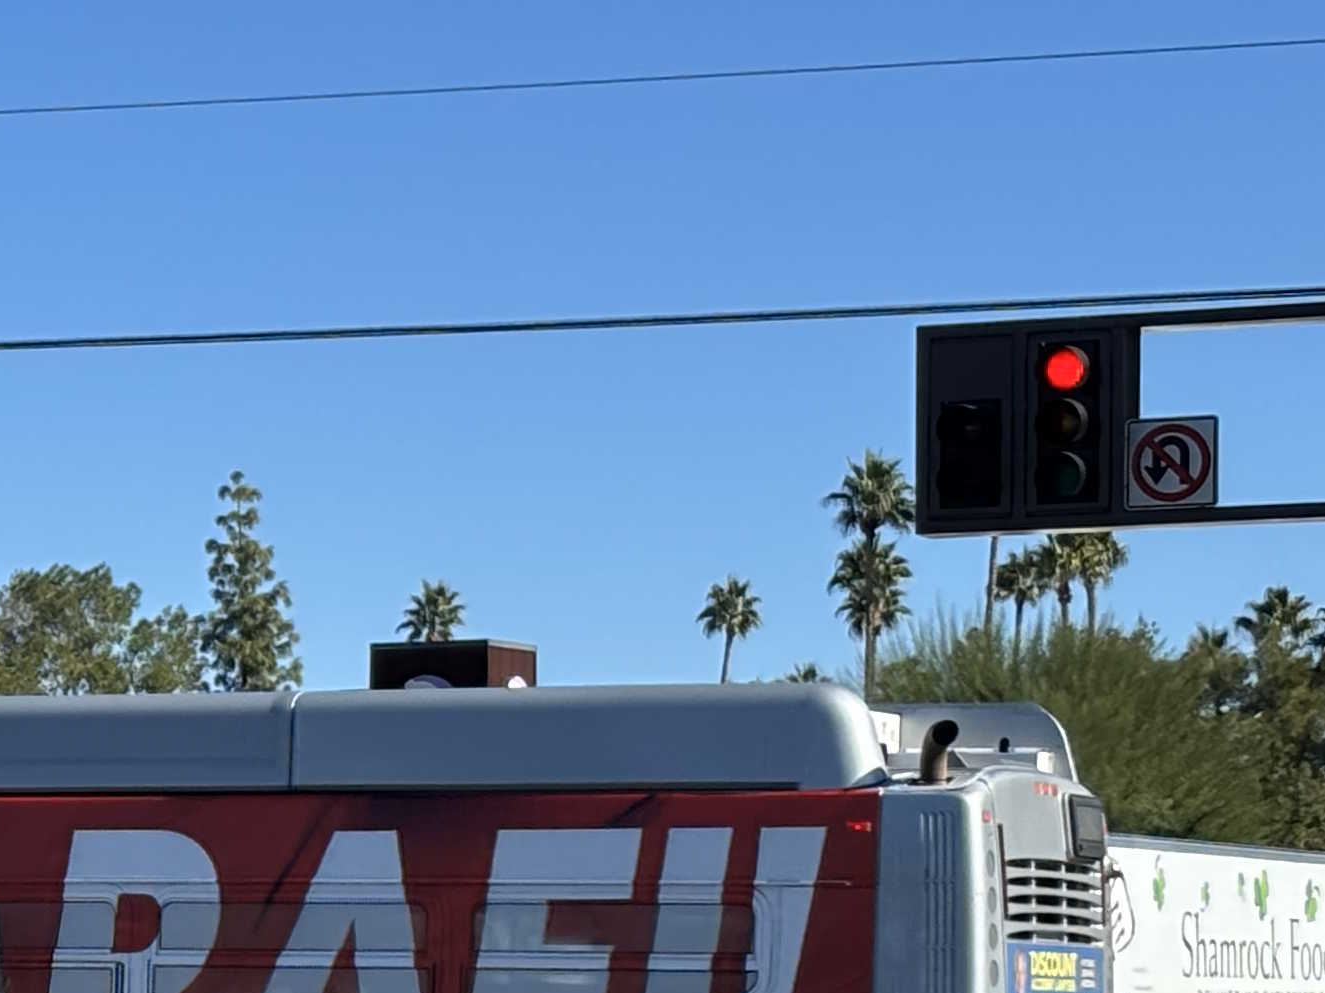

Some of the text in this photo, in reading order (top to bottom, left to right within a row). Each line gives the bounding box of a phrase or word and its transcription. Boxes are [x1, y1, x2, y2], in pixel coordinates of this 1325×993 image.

[1028, 950, 1078, 977] DISCOUNT
[1181, 911, 1325, 981] Shamrock Foo
